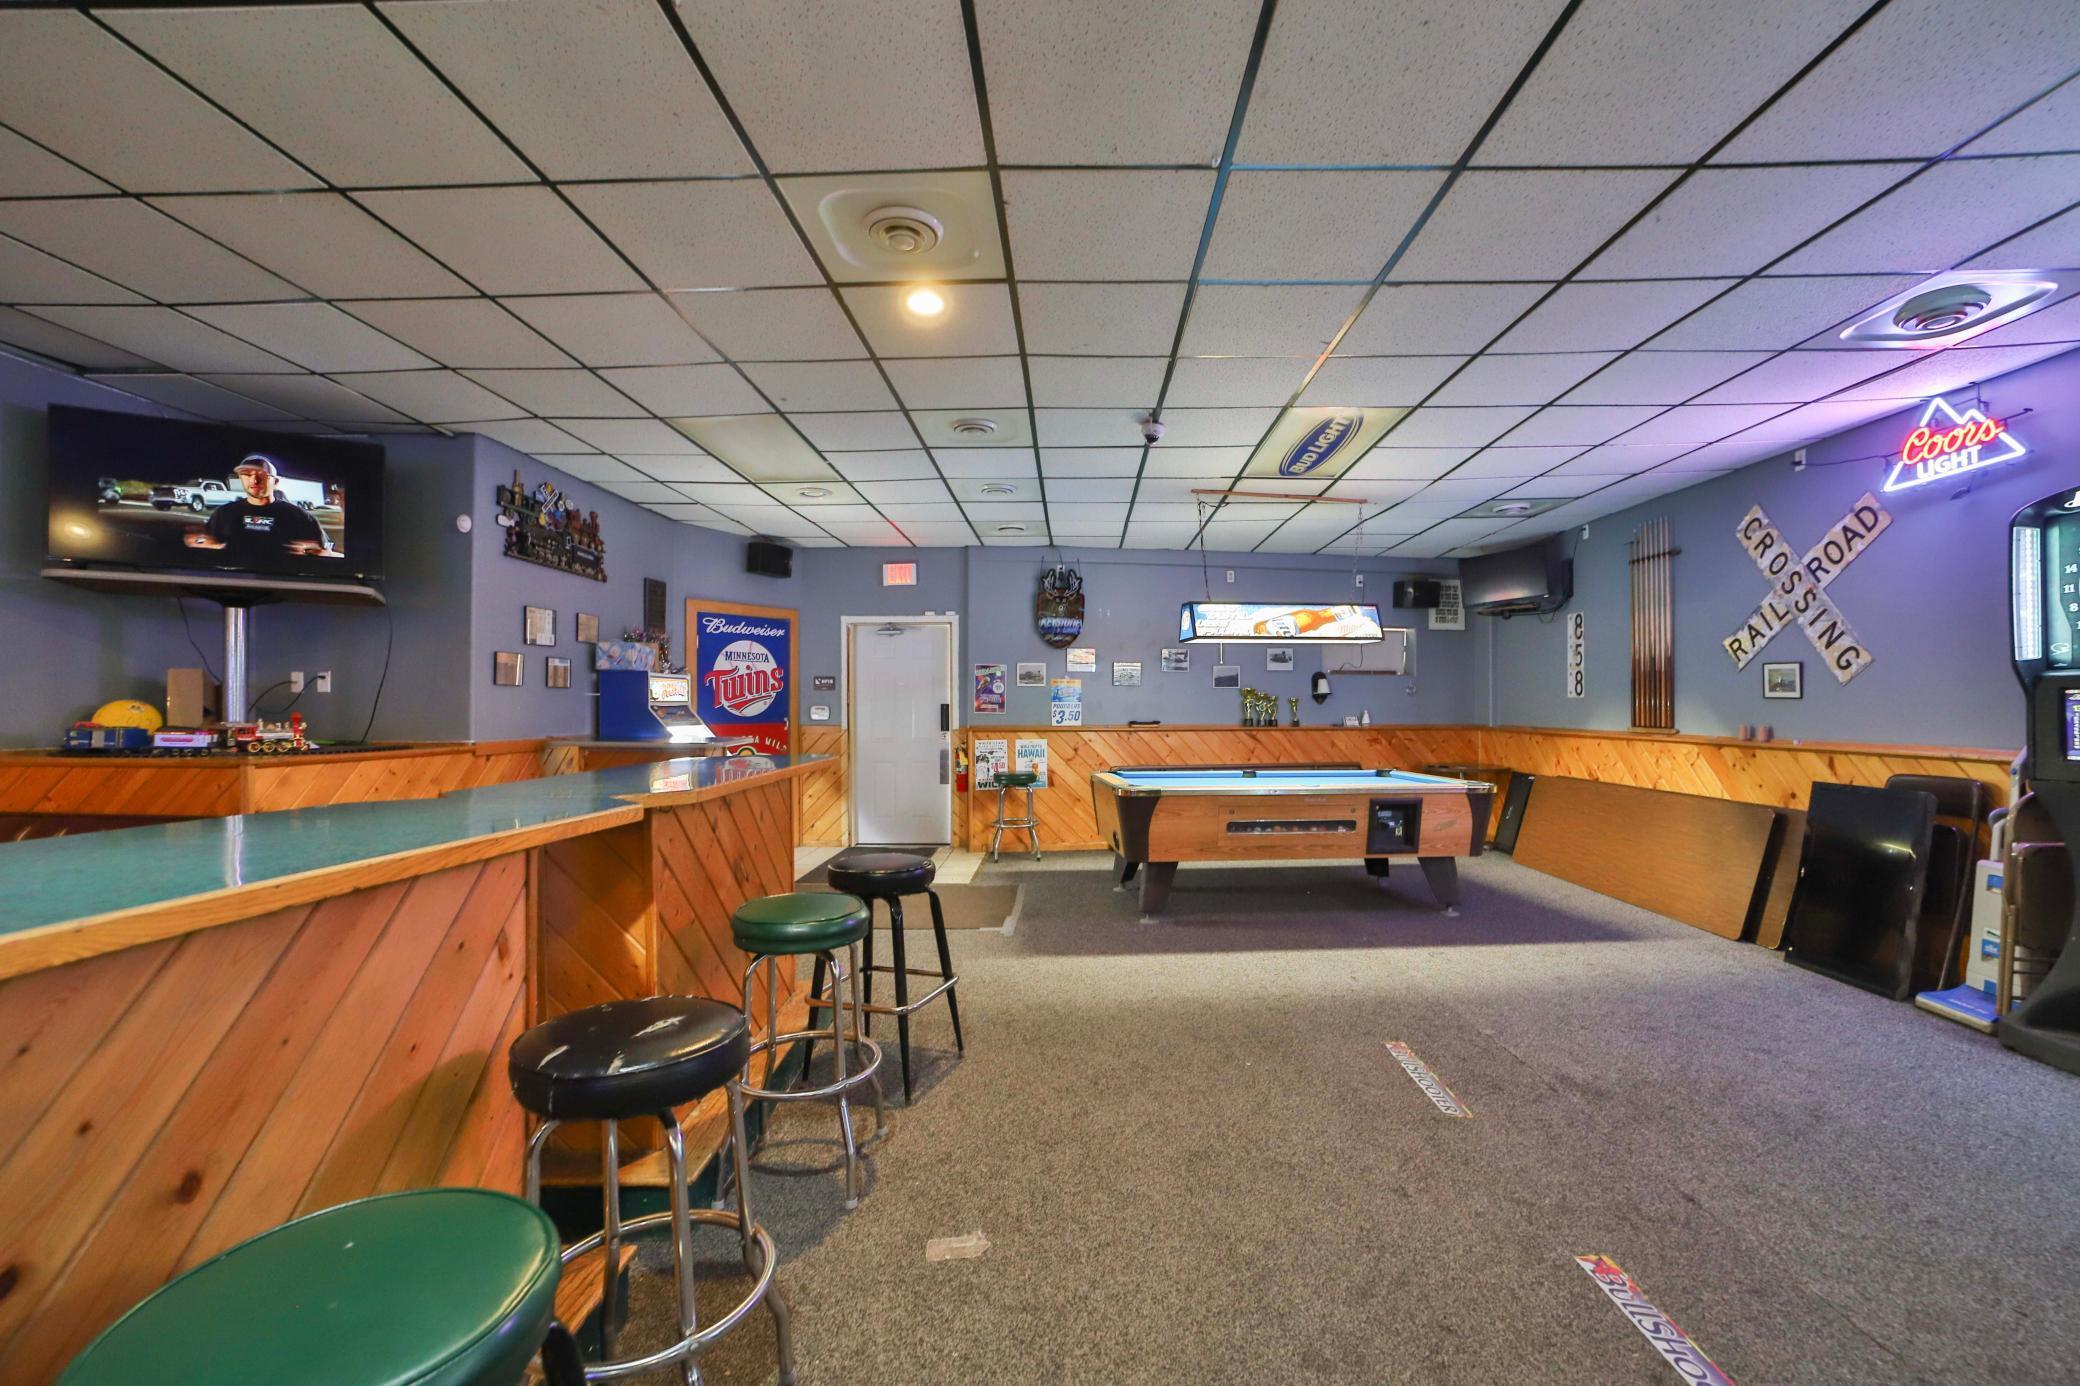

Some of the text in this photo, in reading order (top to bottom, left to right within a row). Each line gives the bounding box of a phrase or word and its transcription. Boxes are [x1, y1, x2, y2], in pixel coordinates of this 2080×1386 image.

[1288, 417, 1352, 474] BUD LIGHT
[1902, 417, 2005, 465] Coors
[1916, 444, 1983, 479] LIGHT
[2064, 563, 2078, 574] 14
[1743, 517, 1861, 671] CROSSING
[2063, 583, 2076, 594] 11
[2069, 602, 2079, 612] 8
[702, 616, 786, 638] Budweiser
[724, 650, 770, 664] MINNESOTA
[704, 664, 784, 709] Twins
[1052, 709, 1081, 725] $3.50
[1017, 748, 1045, 759] HAWAII
[1596, 1271, 1714, 1386] BULLSHO
